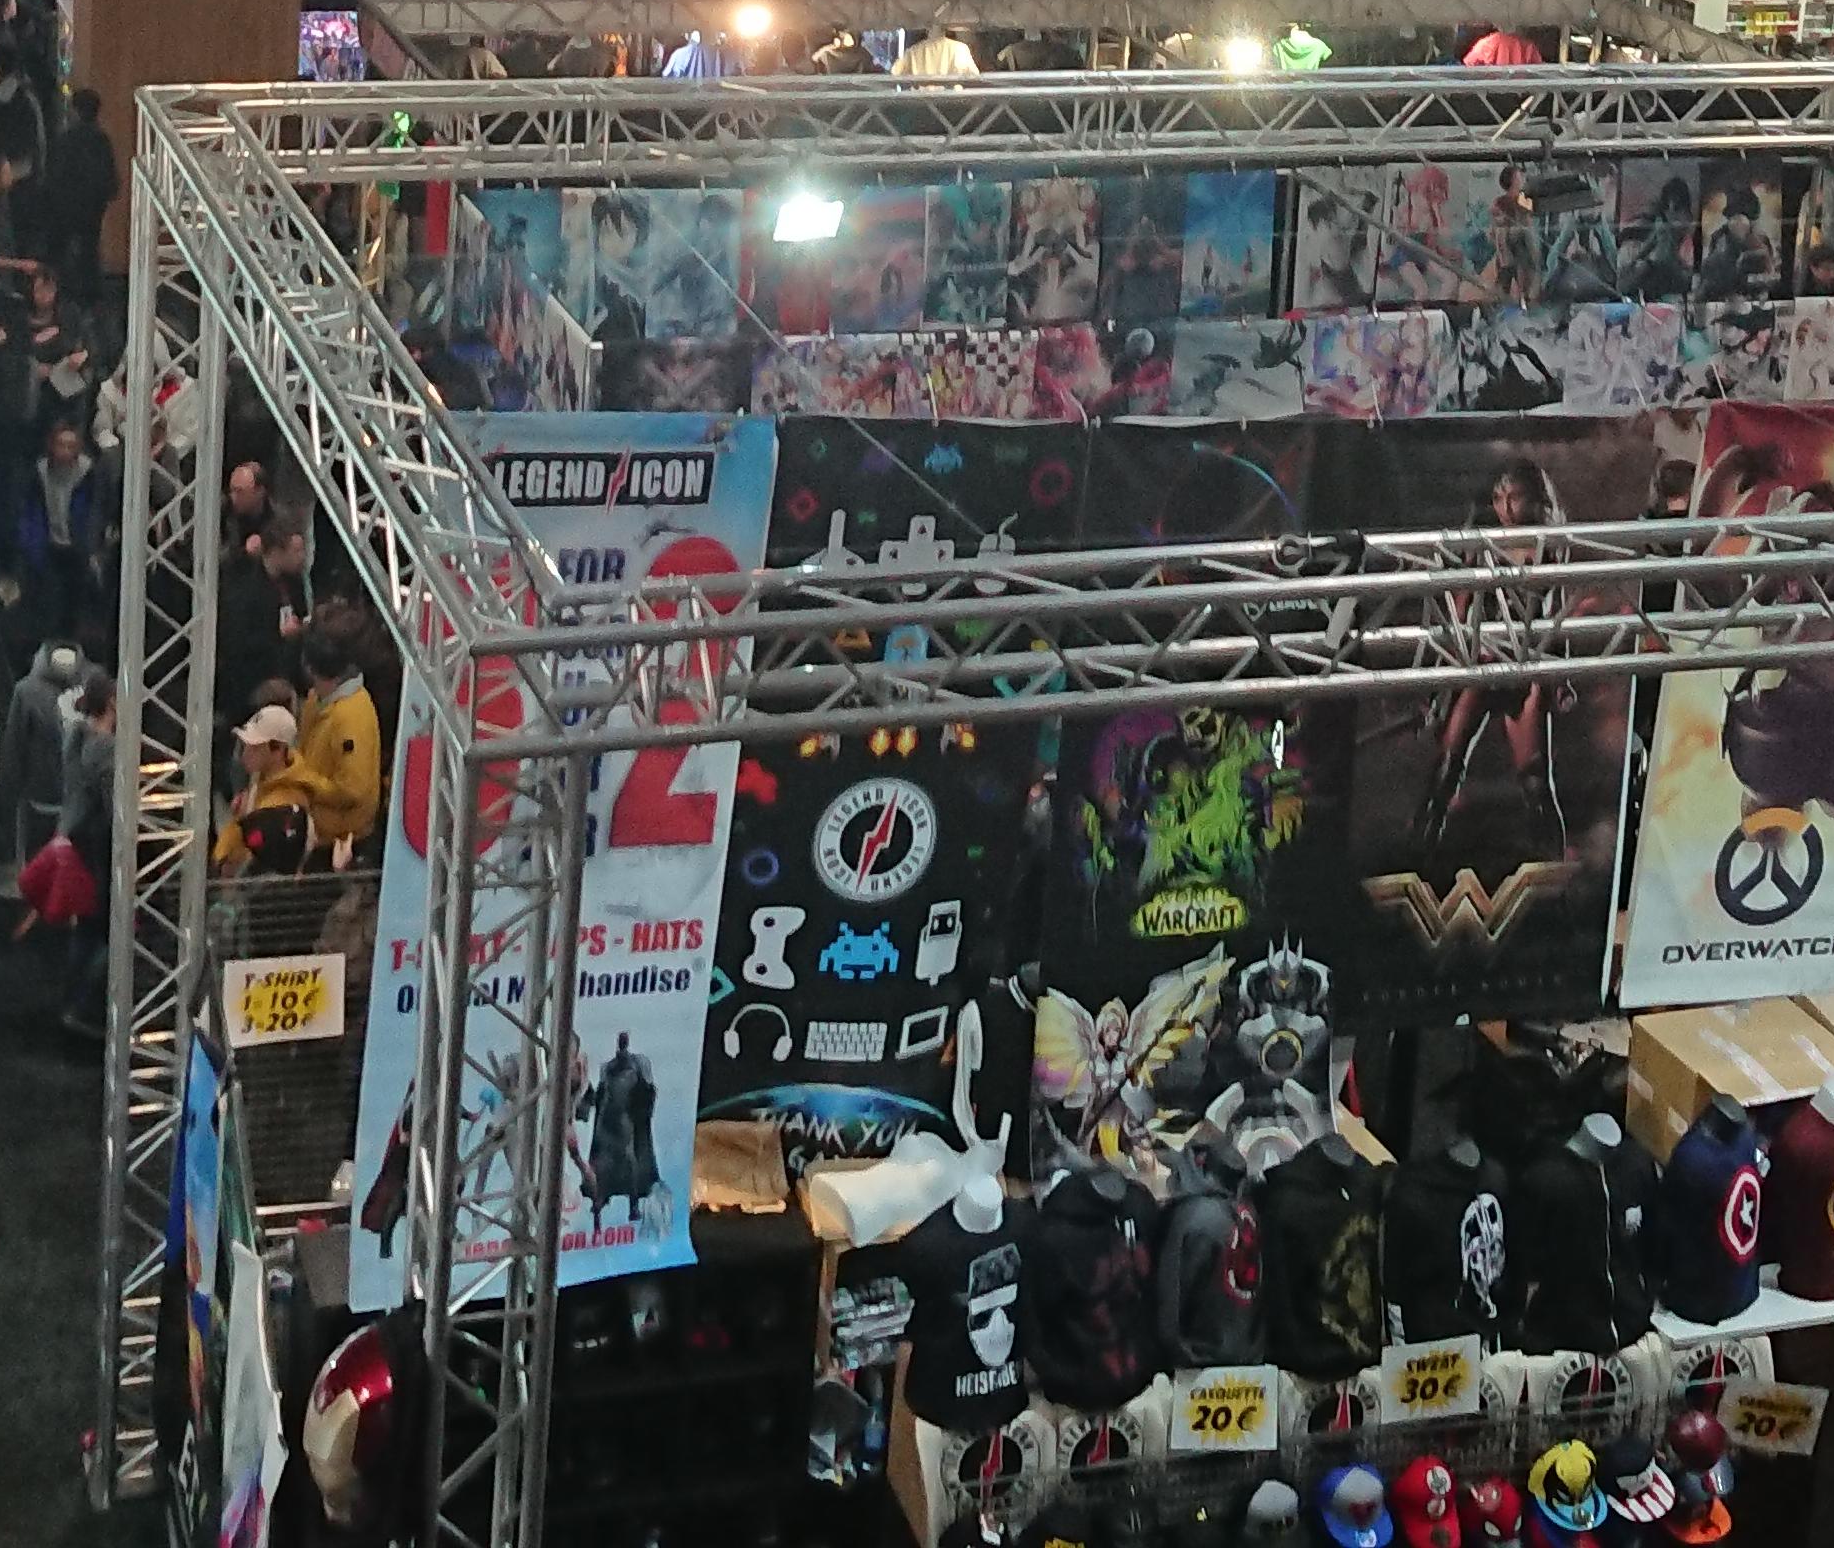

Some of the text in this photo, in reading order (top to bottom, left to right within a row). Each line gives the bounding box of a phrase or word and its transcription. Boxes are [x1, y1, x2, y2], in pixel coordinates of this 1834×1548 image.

[494, 458, 705, 502] LEGEND ICON
[1140, 900, 1240, 935] WARCRAFT
[631, 918, 704, 954] HATS
